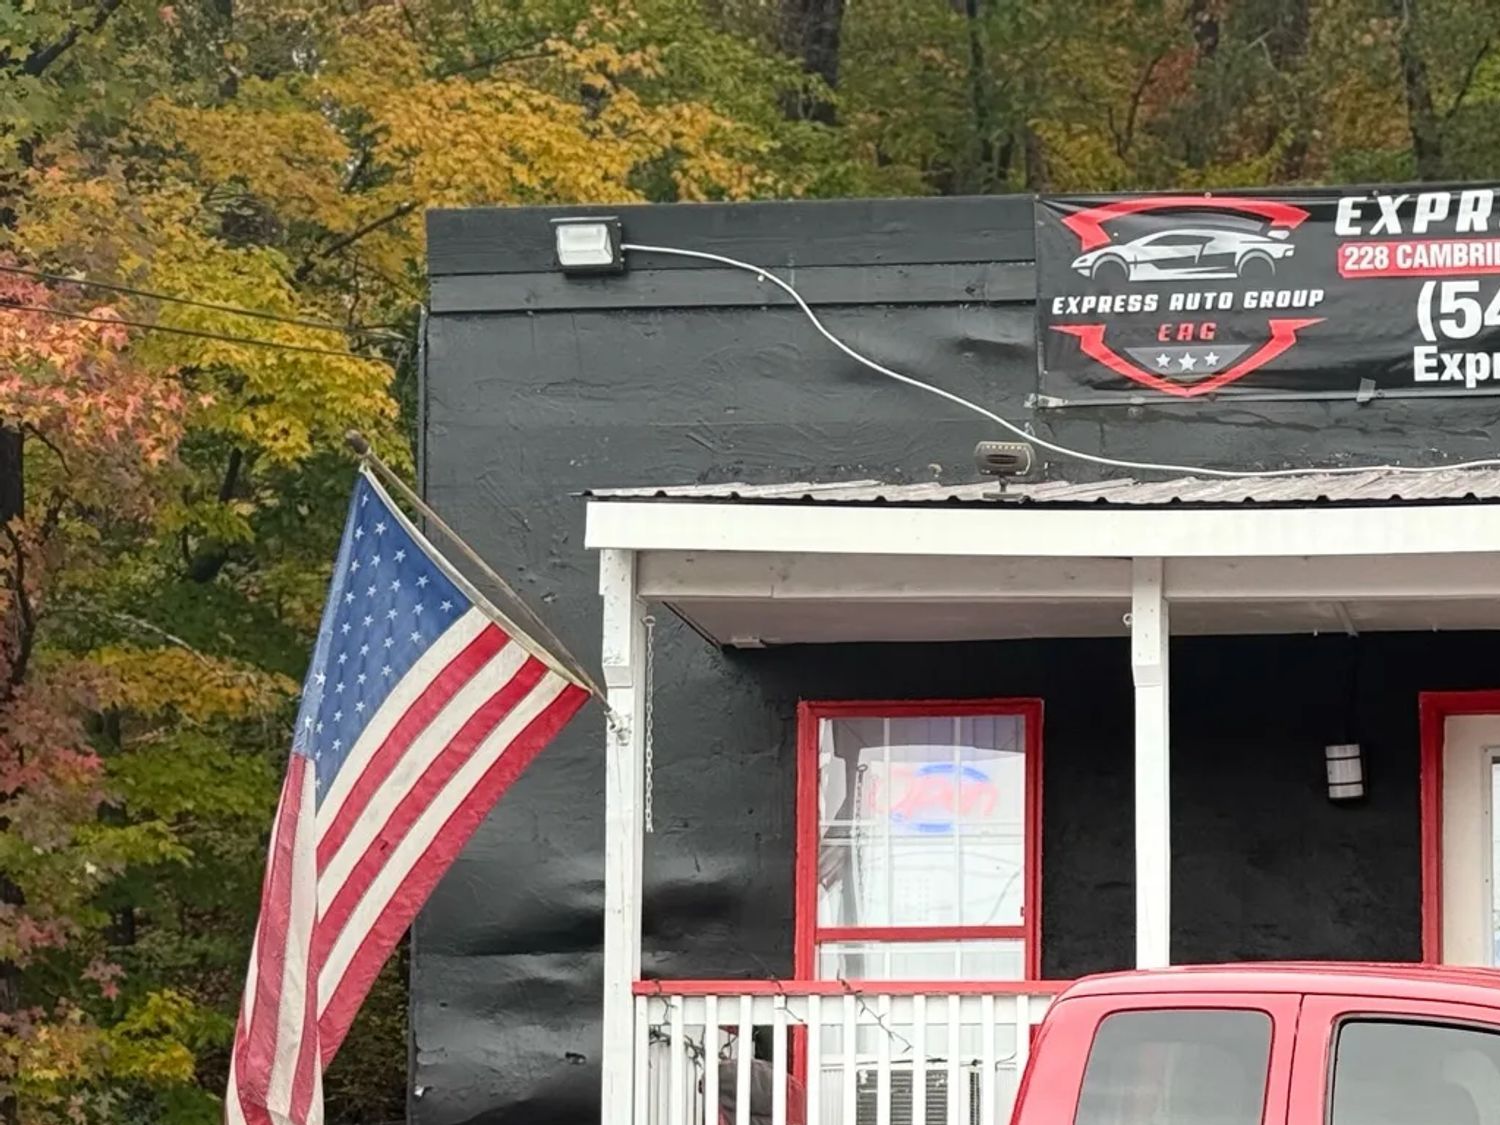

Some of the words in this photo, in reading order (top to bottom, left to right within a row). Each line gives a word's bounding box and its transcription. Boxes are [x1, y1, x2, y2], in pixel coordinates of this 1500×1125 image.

[1344, 246, 1389, 271] 228
[1052, 294, 1158, 315] EXPRESS
[1169, 292, 1233, 311] AUTO
[1243, 289, 1324, 308] GROUP
[1158, 323, 1217, 342] EAG
